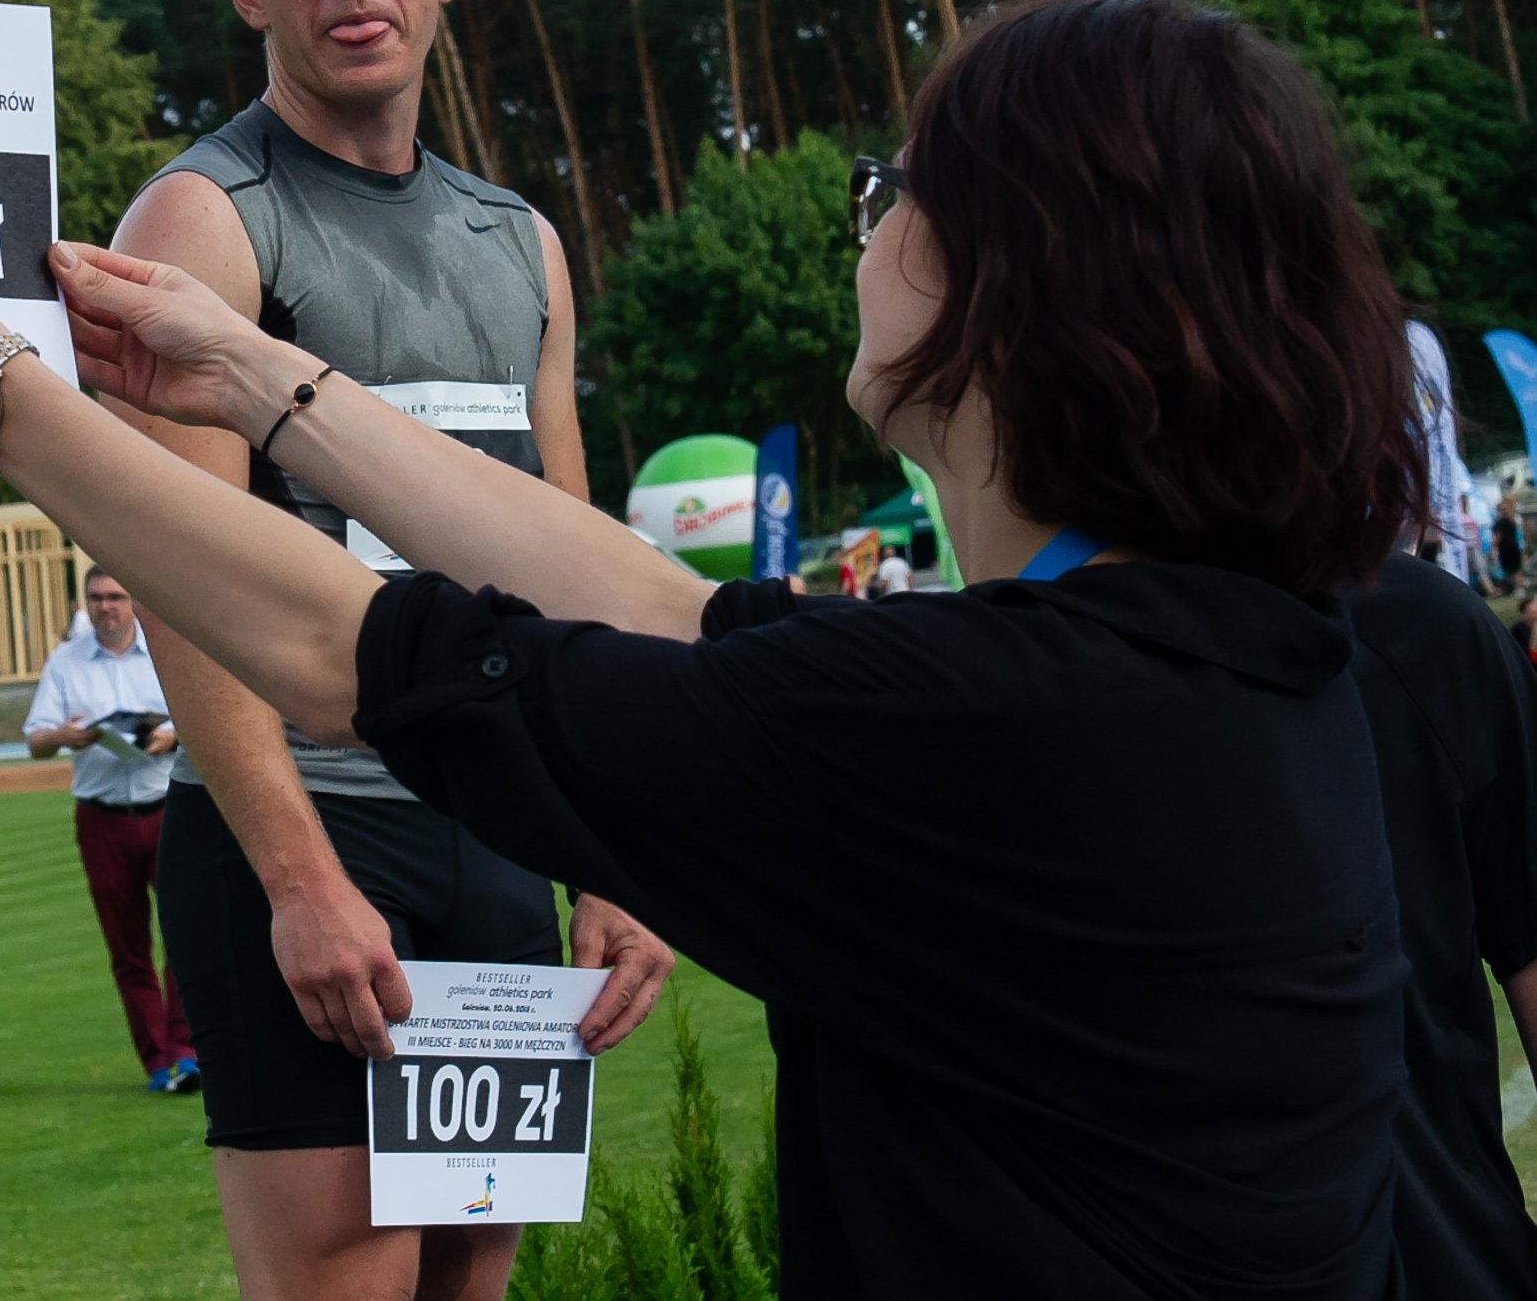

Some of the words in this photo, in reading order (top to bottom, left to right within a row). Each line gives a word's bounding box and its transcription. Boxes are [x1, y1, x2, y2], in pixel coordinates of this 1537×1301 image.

[467, 402, 501, 415] athletics
[503, 403, 522, 416] park
[476, 972, 532, 984] BESTSELLER
[489, 986, 529, 999] athletics
[529, 987, 554, 1001] park
[430, 1018, 490, 1030] MISTRZOSTWA
[492, 1020, 541, 1032] GOLENIOWA
[542, 1022, 579, 1034] AMATOR
[417, 1036, 453, 1048] MIEJSCE
[458, 1037, 478, 1049] BIEG
[479, 1038, 492, 1049] NA
[493, 1039, 513, 1050] 3000
[514, 1039, 523, 1050] M
[401, 1064, 500, 1142] 100
[515, 1068, 561, 1141] zł
[446, 1158, 497, 1168] BESTSELLER
